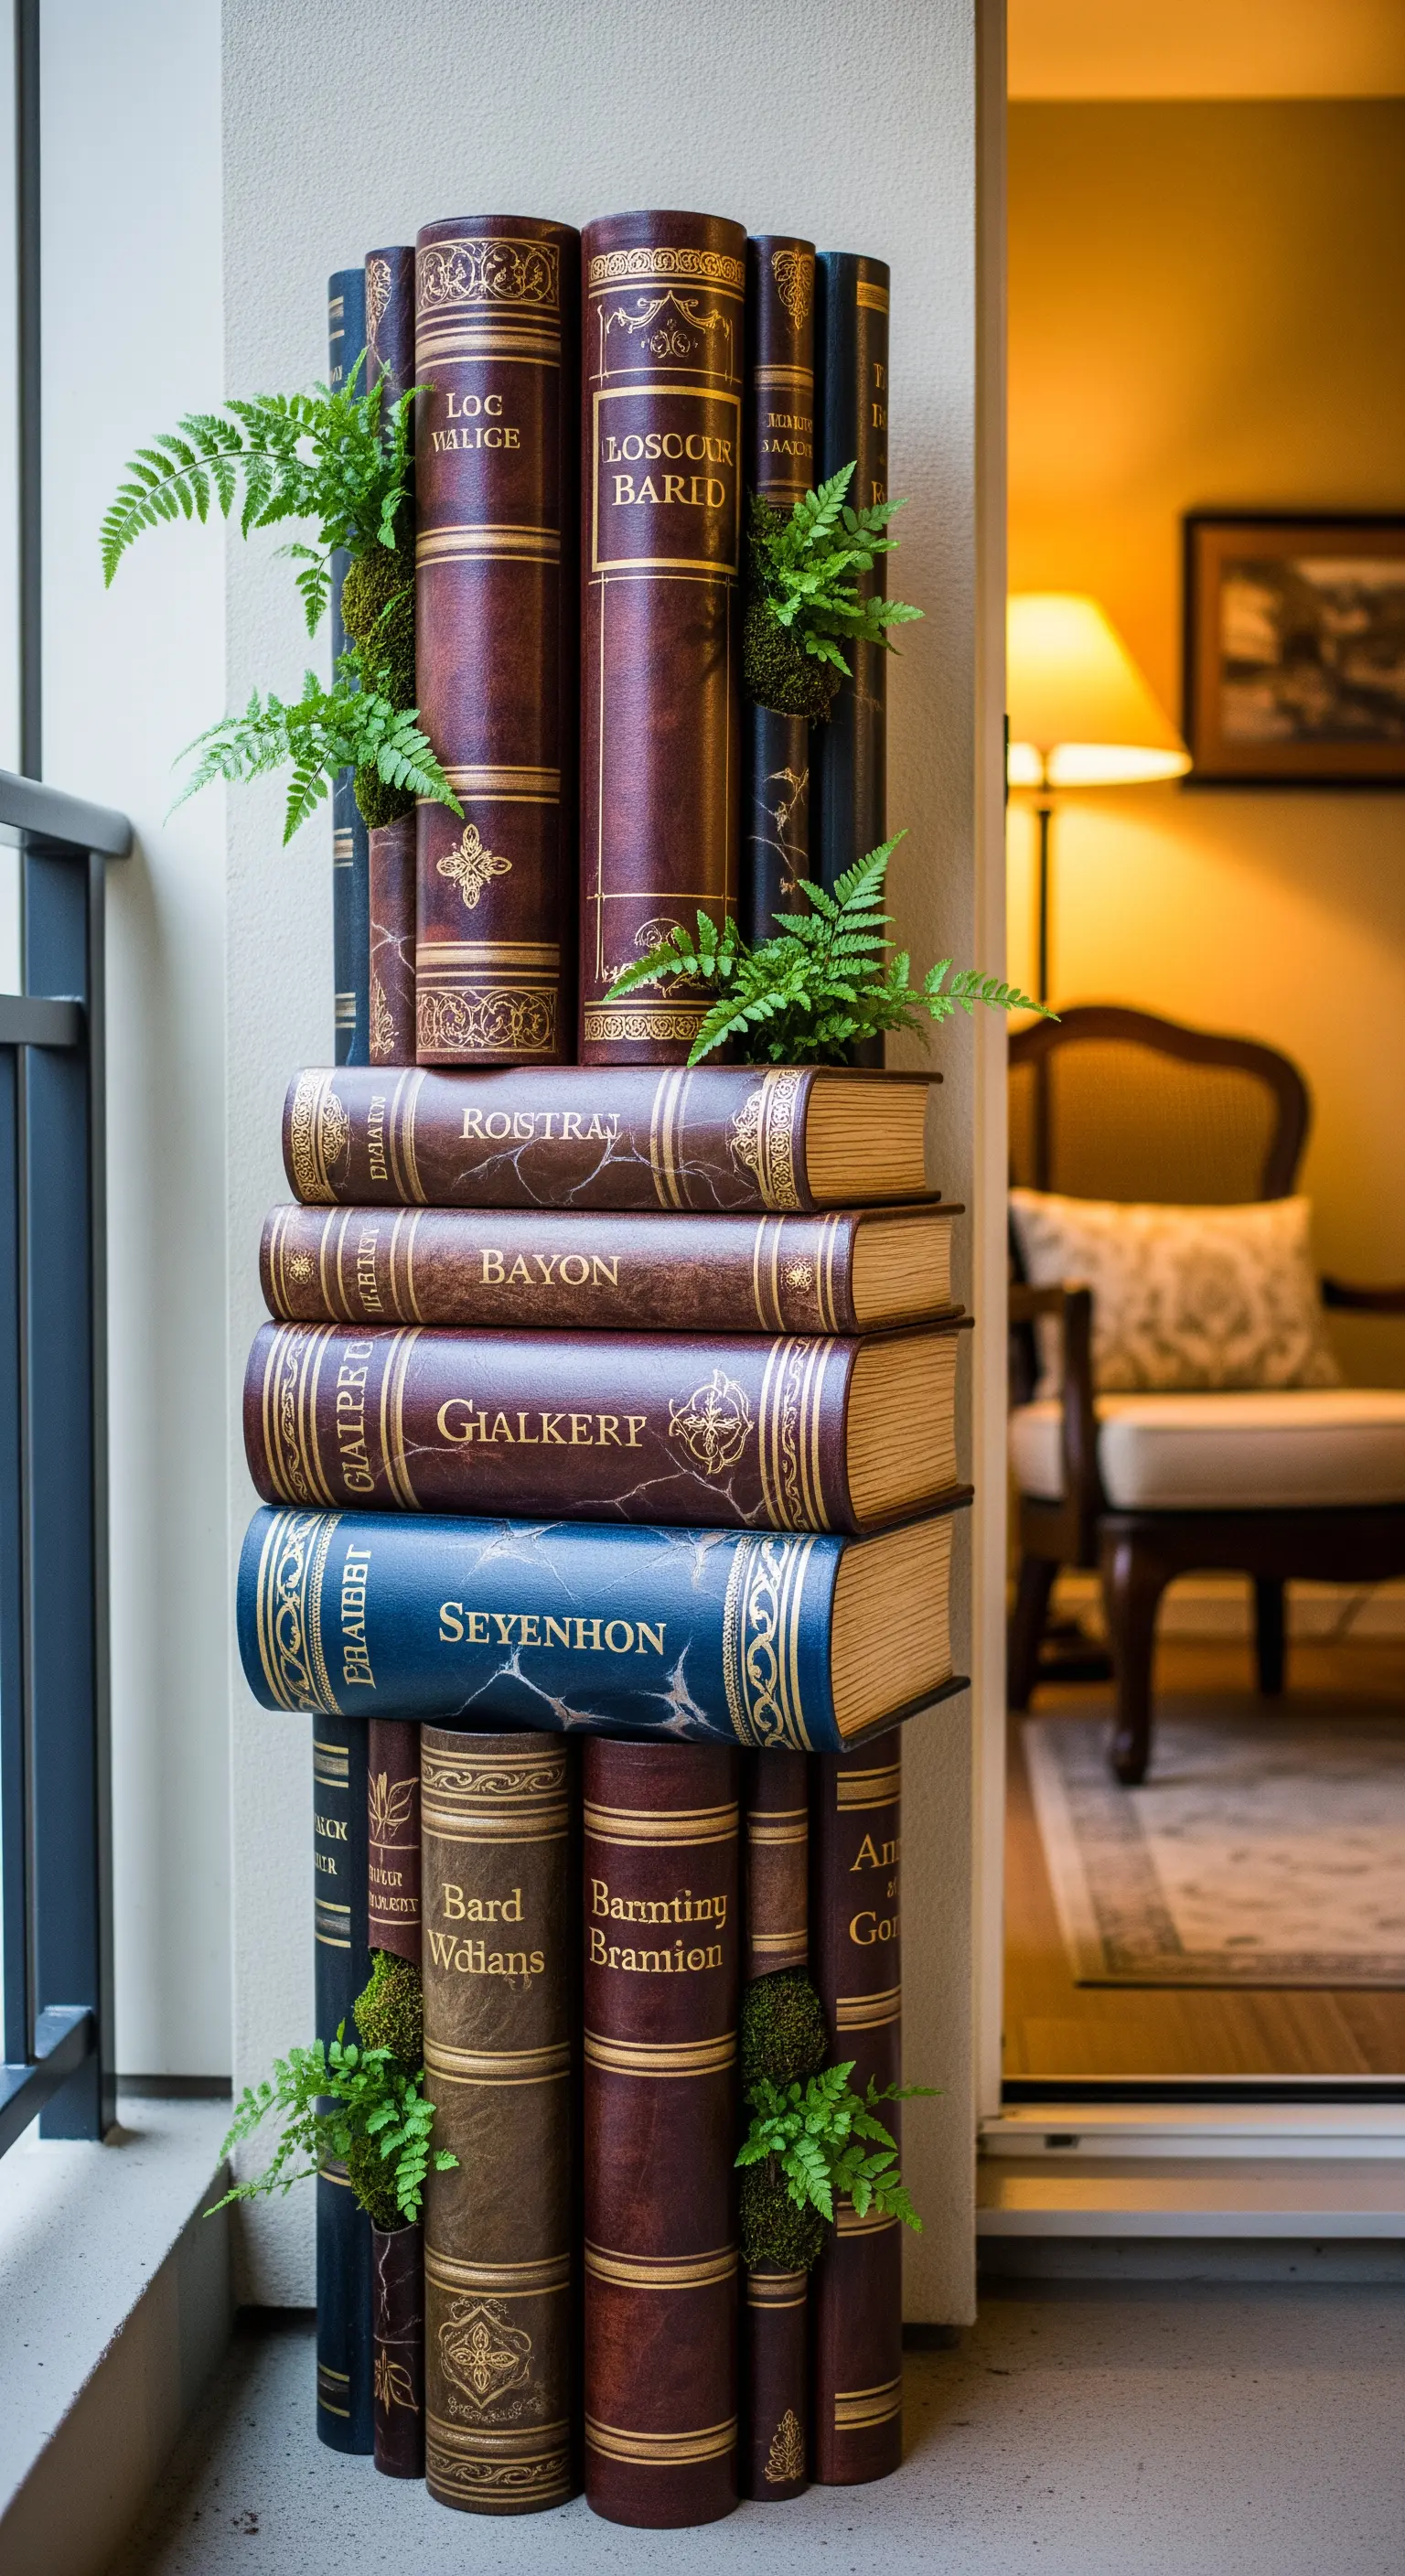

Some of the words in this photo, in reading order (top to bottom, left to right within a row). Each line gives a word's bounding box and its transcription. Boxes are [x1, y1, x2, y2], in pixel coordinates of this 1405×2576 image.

[479, 1250, 622, 1286] BAYON
[439, 1602, 667, 1656] SEYENHON
[442, 1883, 525, 1922] Bard
